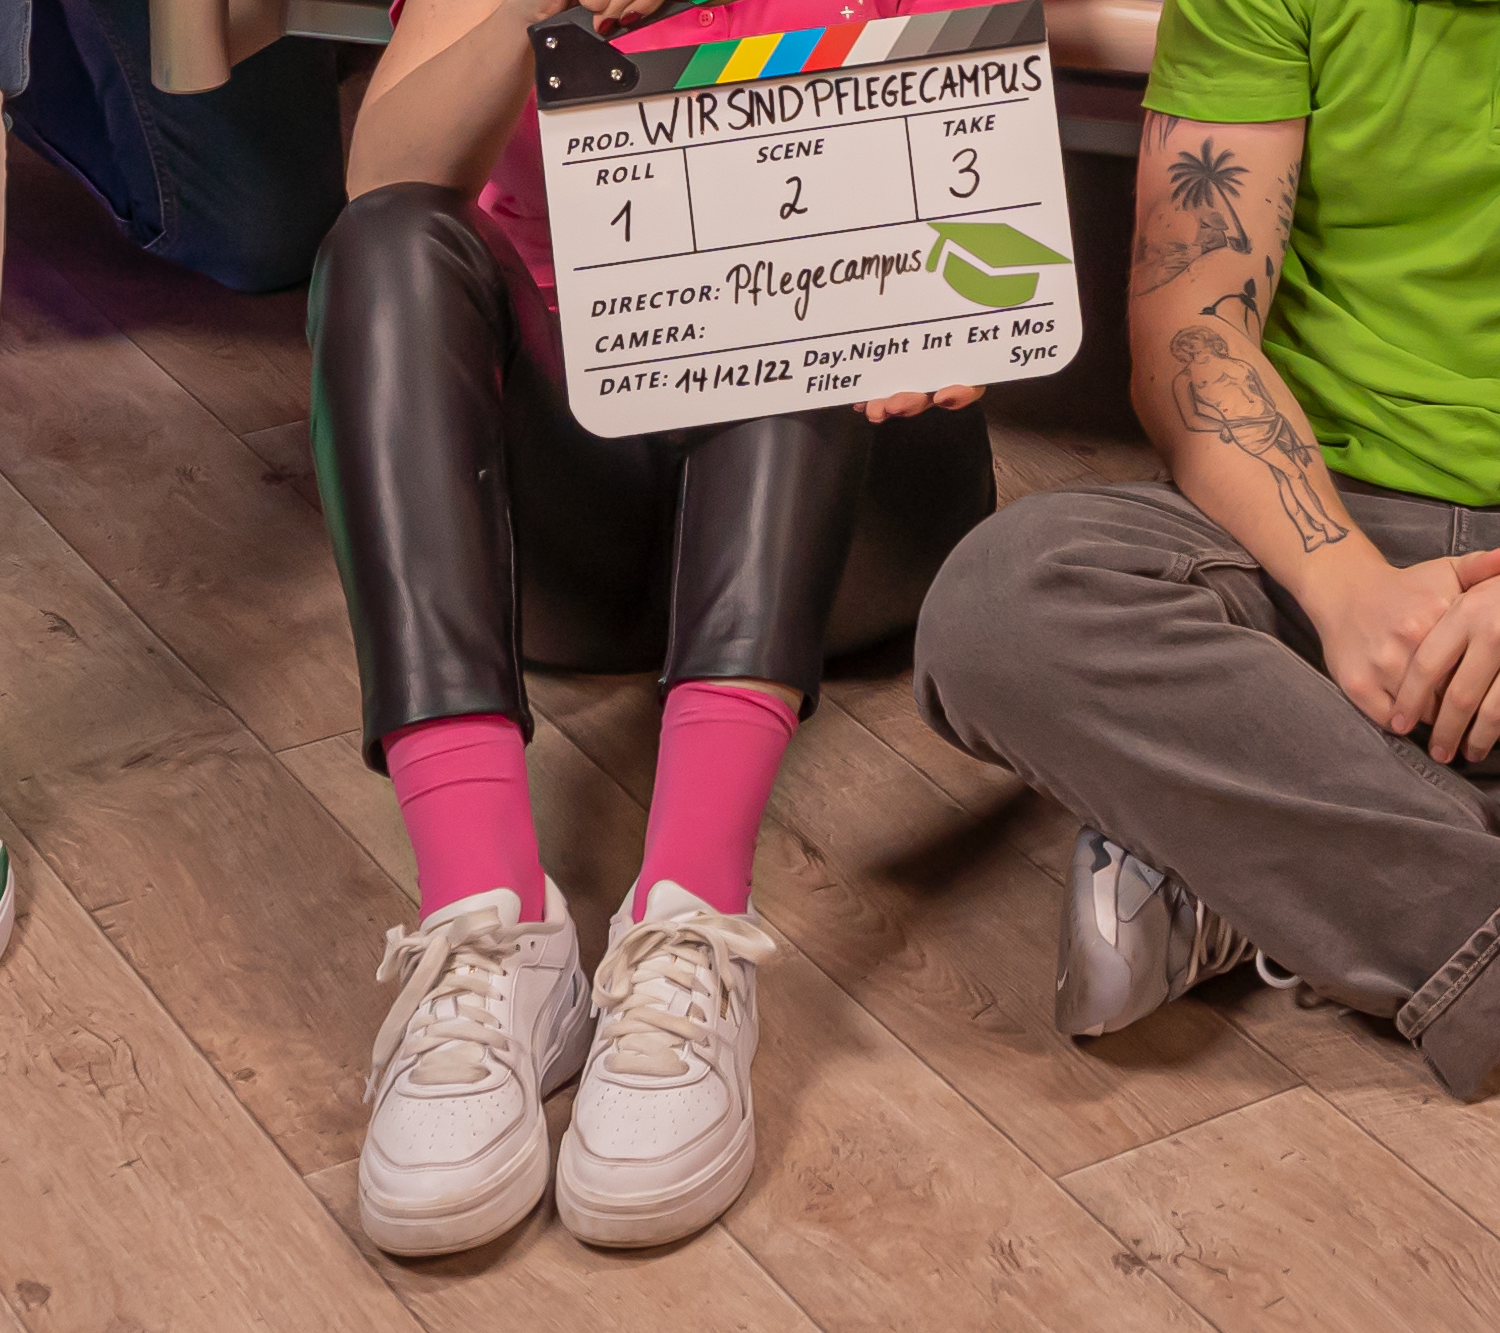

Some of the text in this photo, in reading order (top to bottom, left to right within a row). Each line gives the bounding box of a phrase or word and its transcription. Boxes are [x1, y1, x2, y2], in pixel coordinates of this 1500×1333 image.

[942, 114, 996, 137] TAKE
[566, 131, 635, 155] PROD.
[756, 138, 825, 164] SCENE
[595, 162, 655, 186] ROLL
[948, 147, 981, 199] 3
[779, 175, 808, 220] 2
[610, 199, 632, 242] 1
[590, 284, 721, 318] DIRECTOR:
[594, 323, 706, 354] CAMERA:
[921, 331, 953, 351] Int
[966, 324, 1000, 345] Ext
[1010, 318, 1056, 338] Mos
[1009, 343, 1059, 367] Sync
[599, 370, 669, 395] DATE:
[805, 371, 862, 394] Filter
